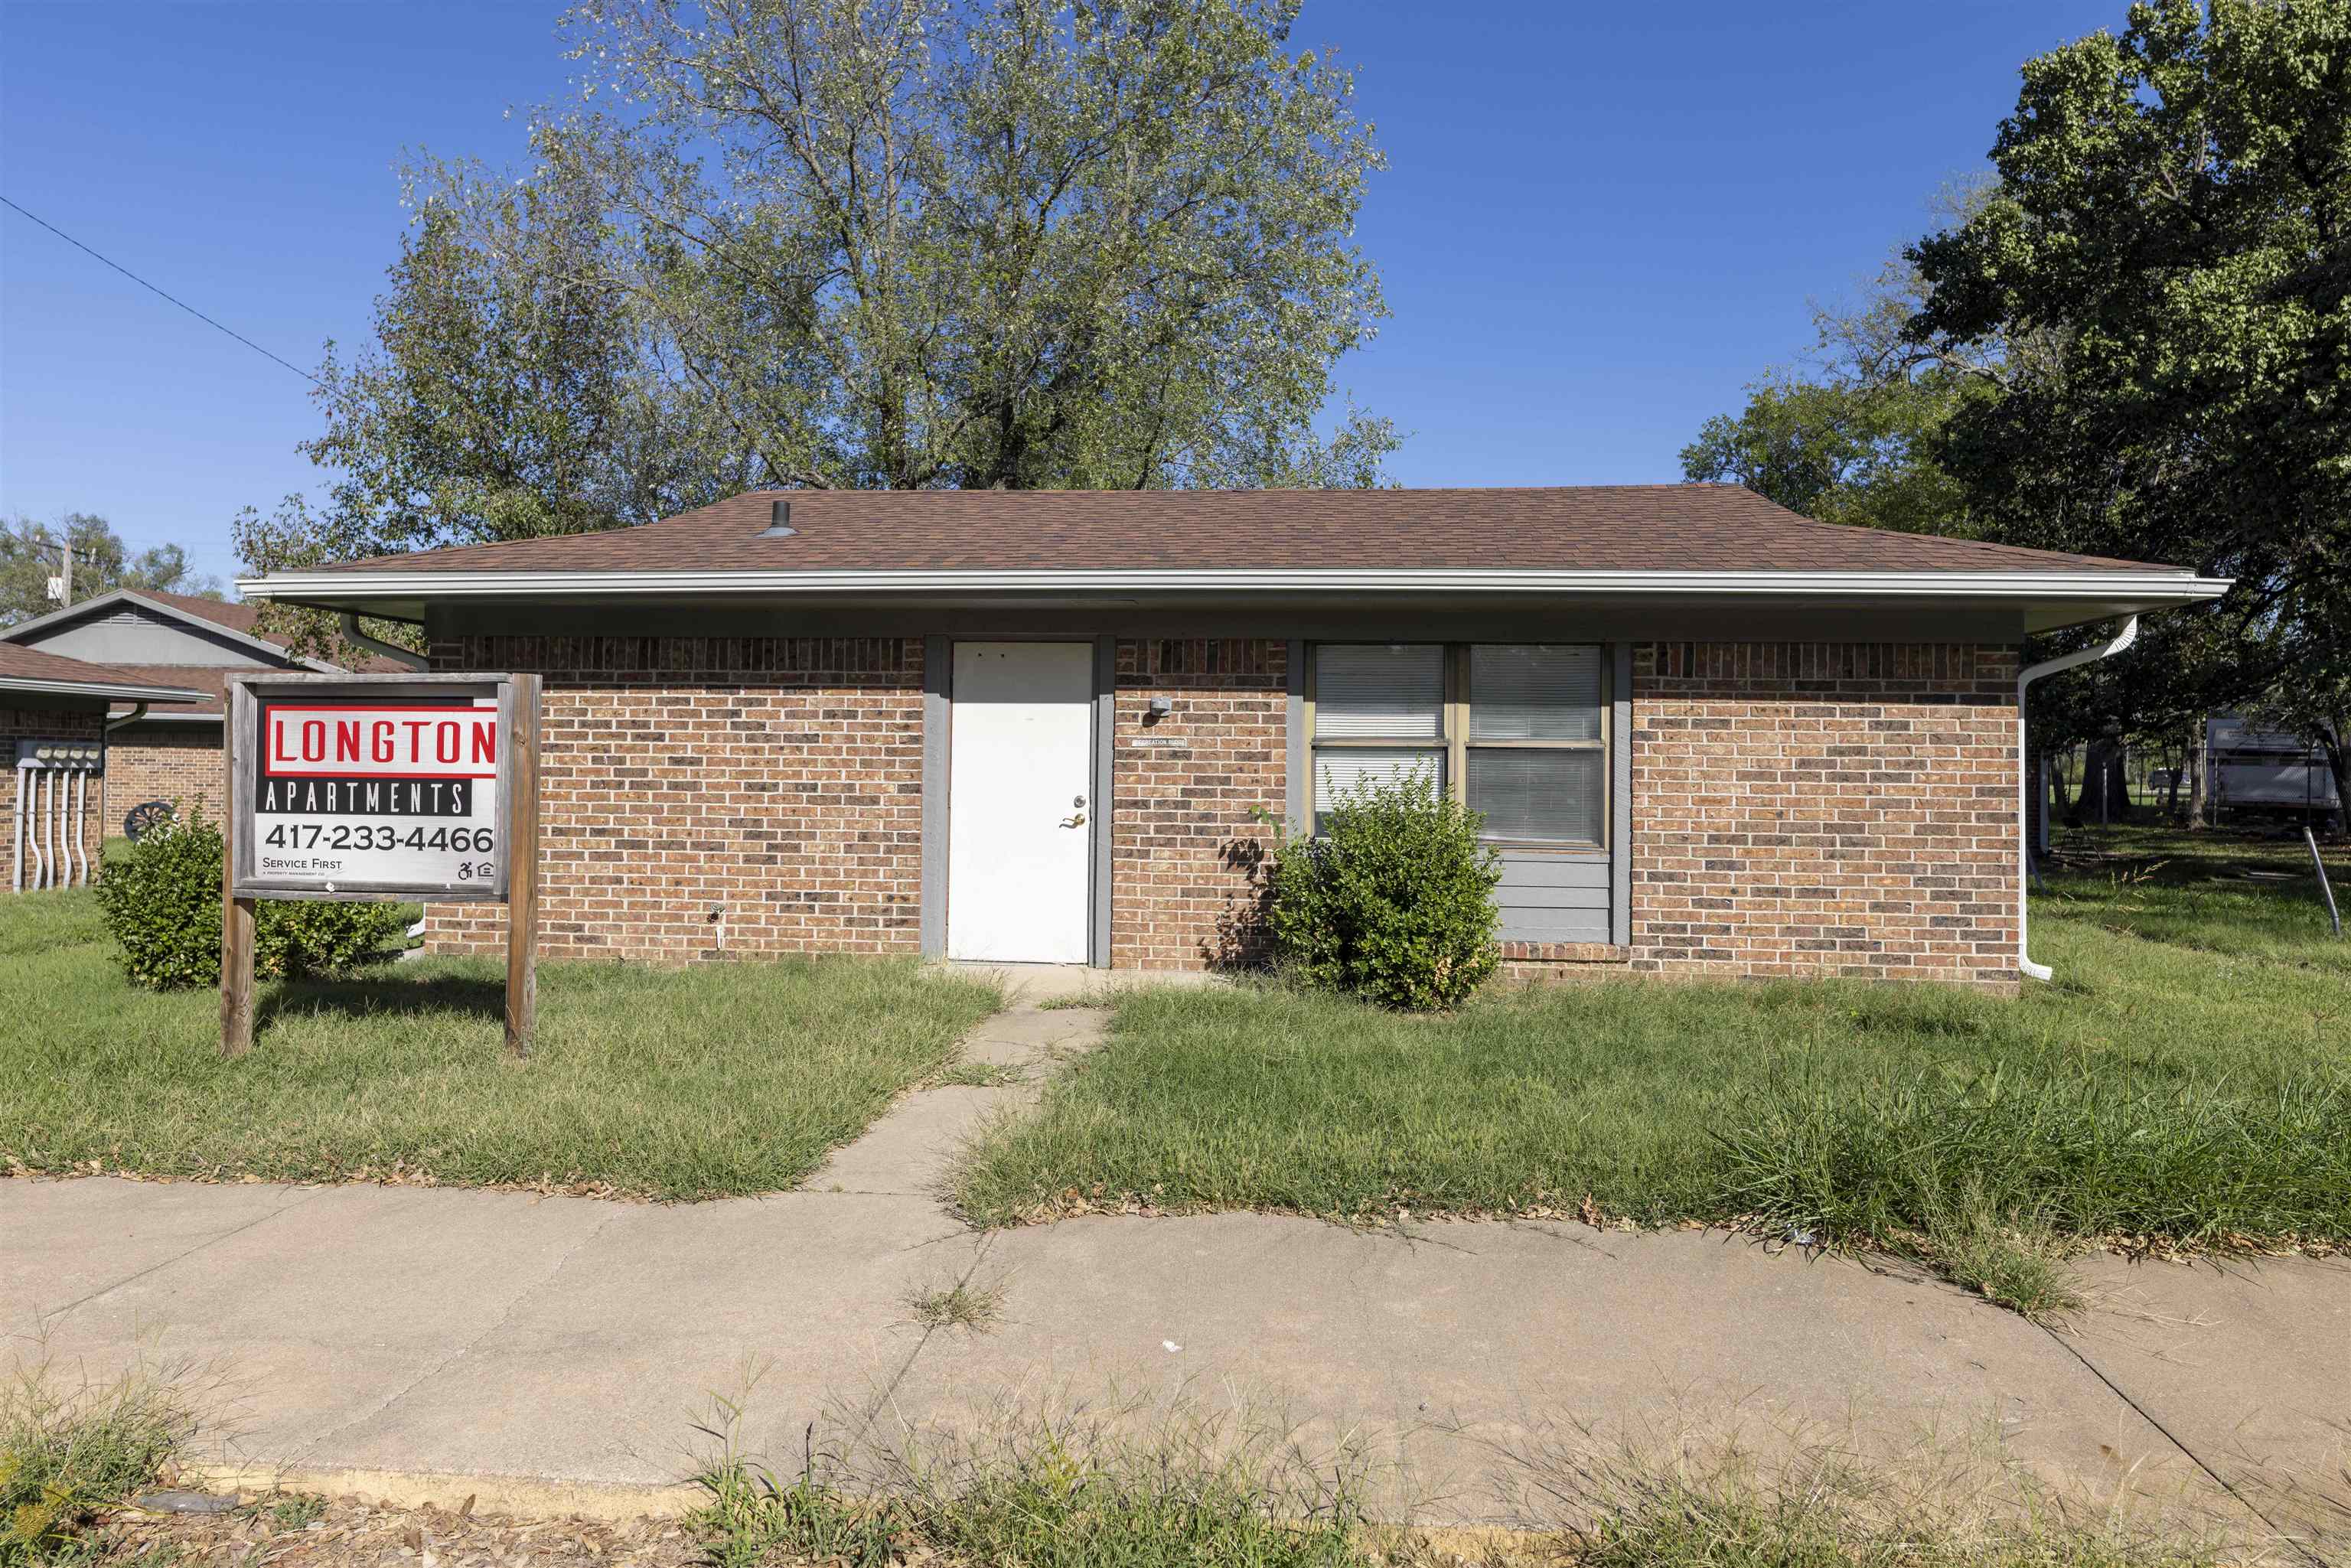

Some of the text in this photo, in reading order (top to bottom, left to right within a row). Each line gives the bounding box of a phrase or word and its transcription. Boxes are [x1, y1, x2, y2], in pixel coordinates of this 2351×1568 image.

[276, 720, 496, 764] LONGTON
[266, 781, 462, 814] APARTMENTS
[266, 824, 494, 853] 417-233-4466
[262, 857, 343, 869] SERVICE FIRST
